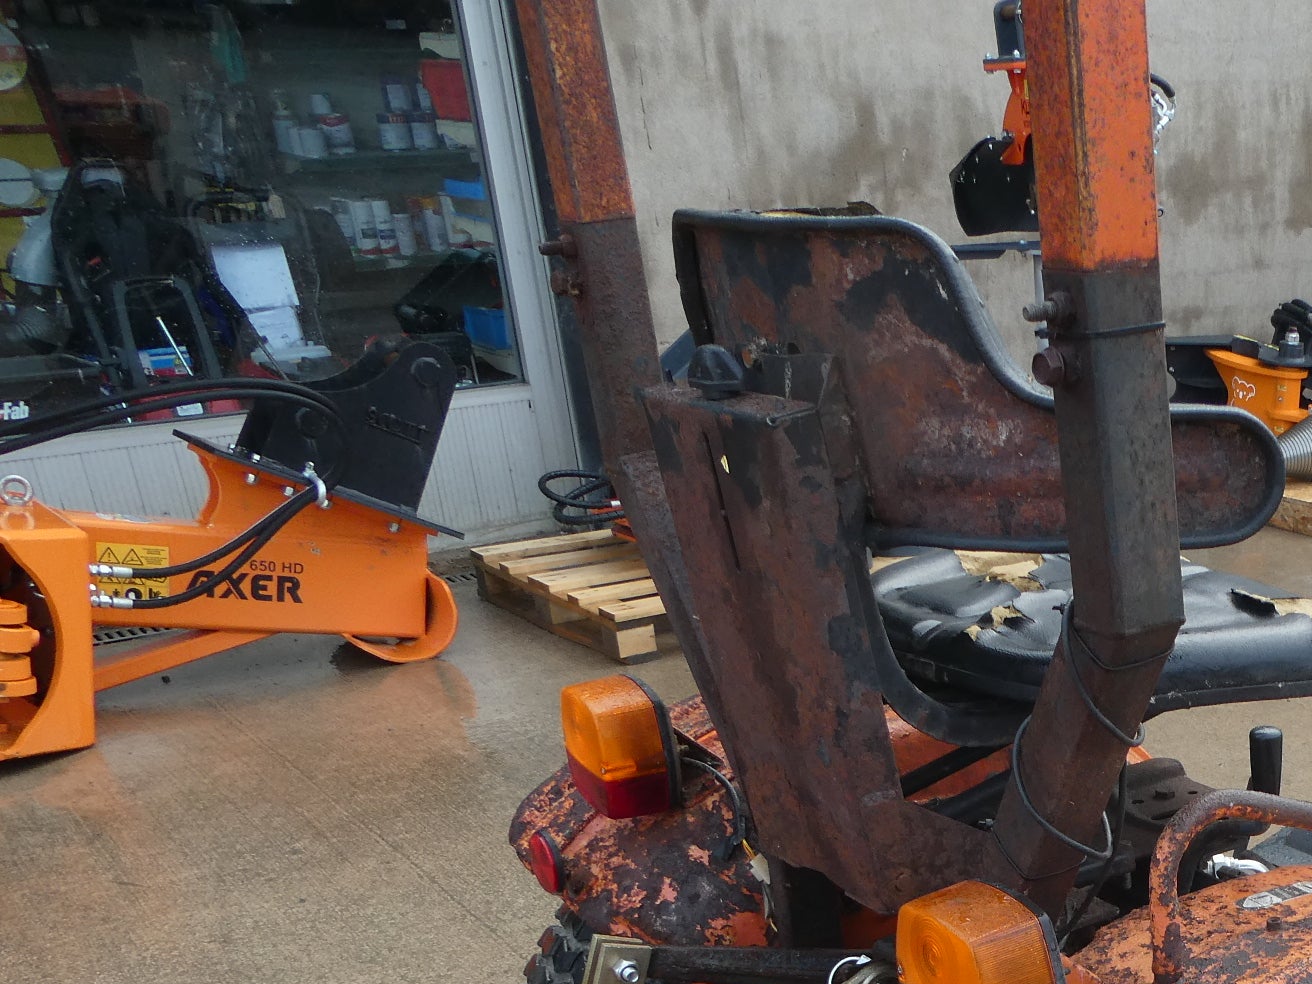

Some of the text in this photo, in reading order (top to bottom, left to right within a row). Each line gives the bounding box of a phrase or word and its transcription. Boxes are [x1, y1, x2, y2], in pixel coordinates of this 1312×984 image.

[250, 559, 304, 574] 650 HD
[186, 570, 304, 604] AXER
